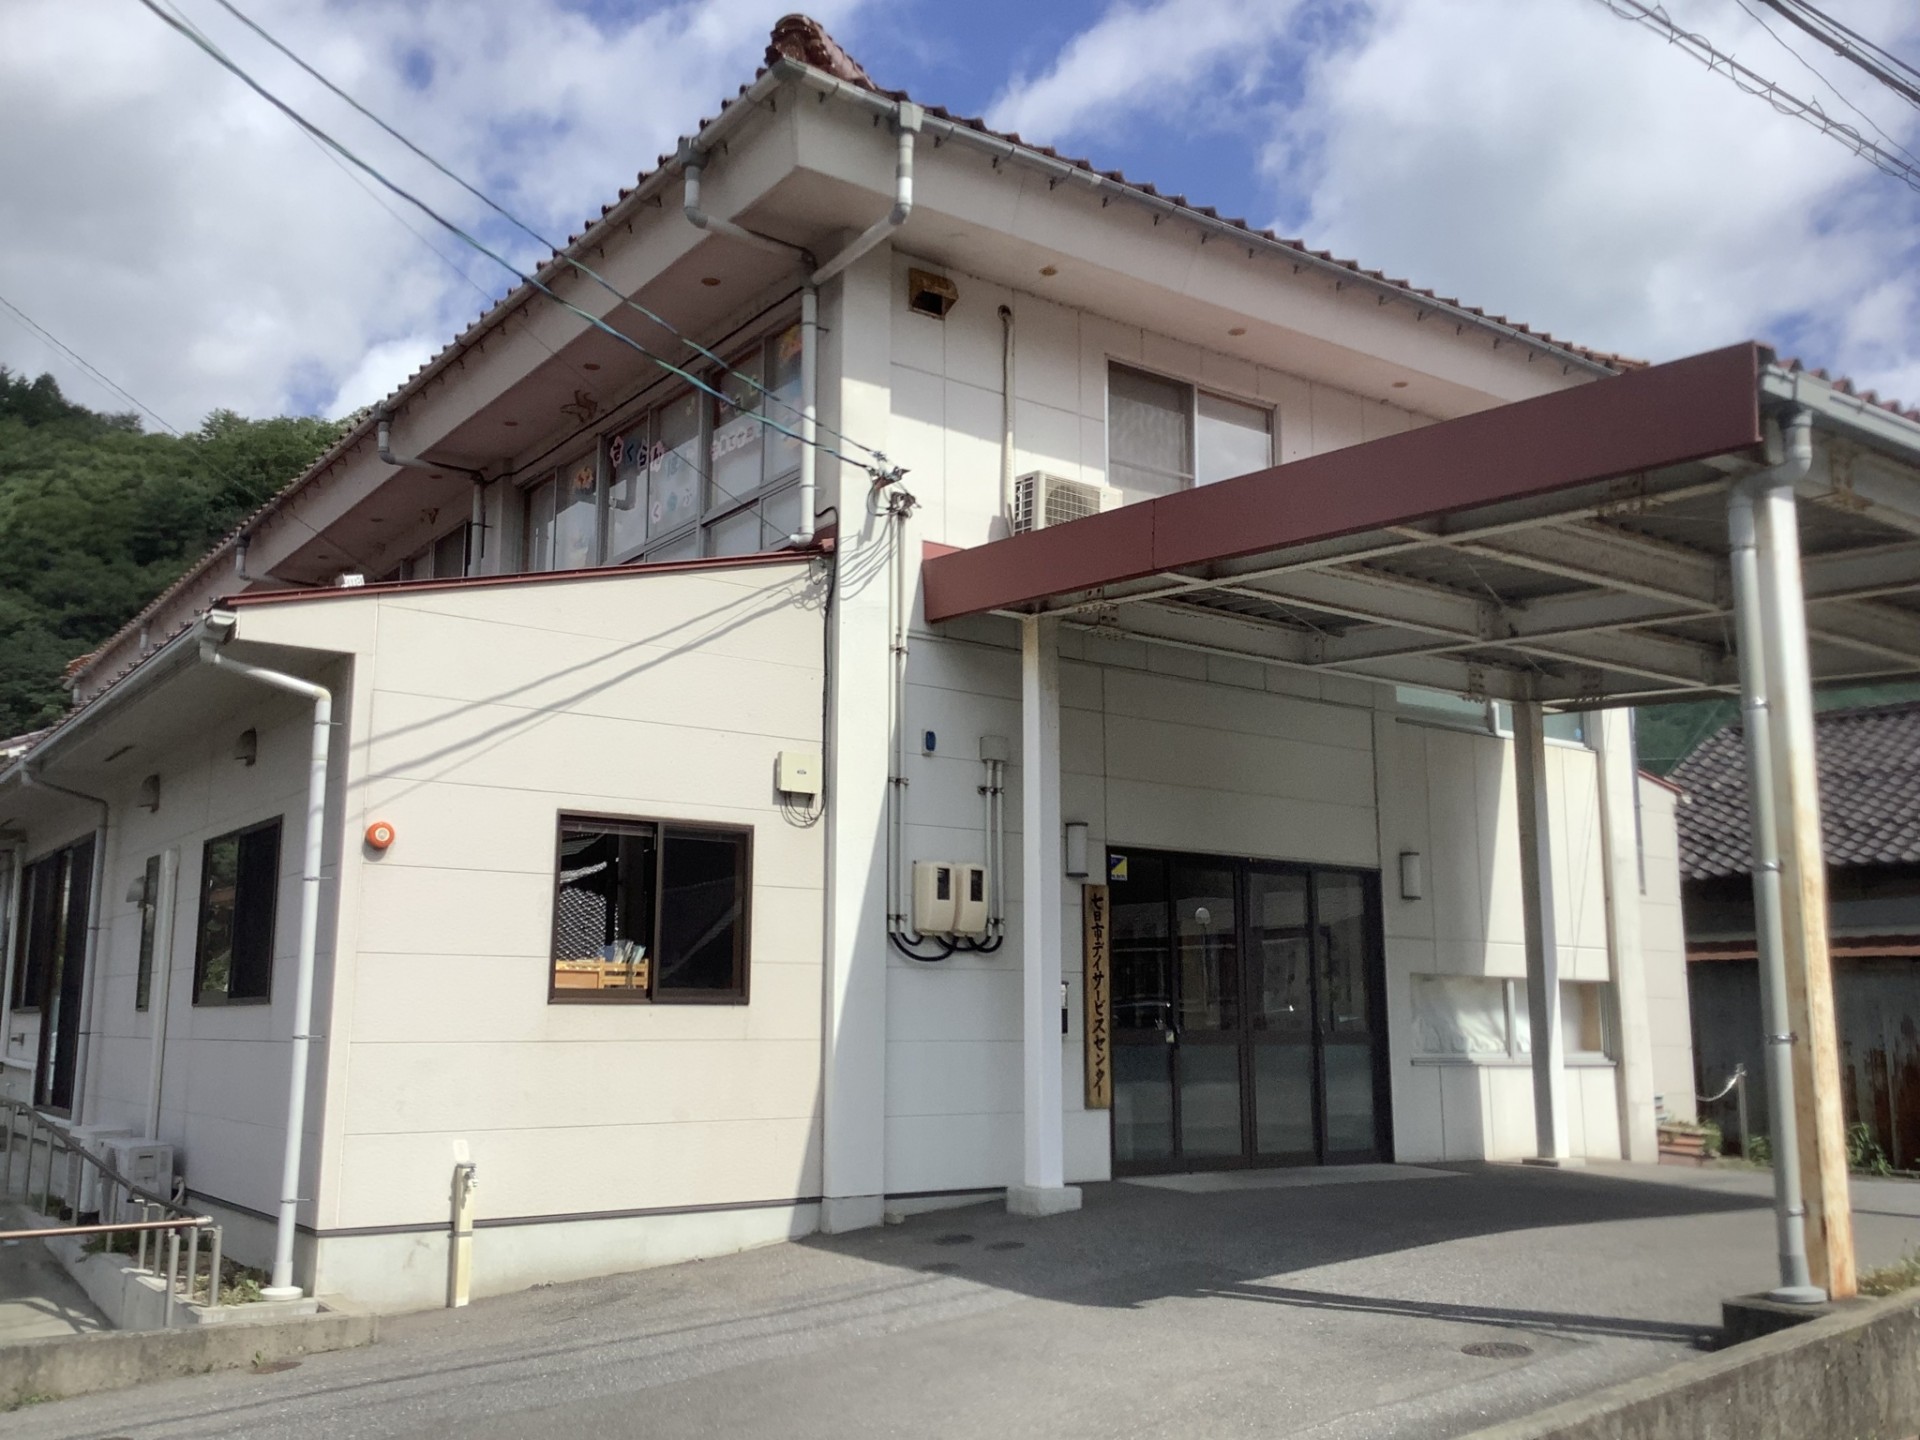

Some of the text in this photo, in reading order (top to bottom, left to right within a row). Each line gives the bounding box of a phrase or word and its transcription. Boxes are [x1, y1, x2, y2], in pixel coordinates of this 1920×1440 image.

[1090, 892, 1106, 1098] 七日市デイサービスセンター
